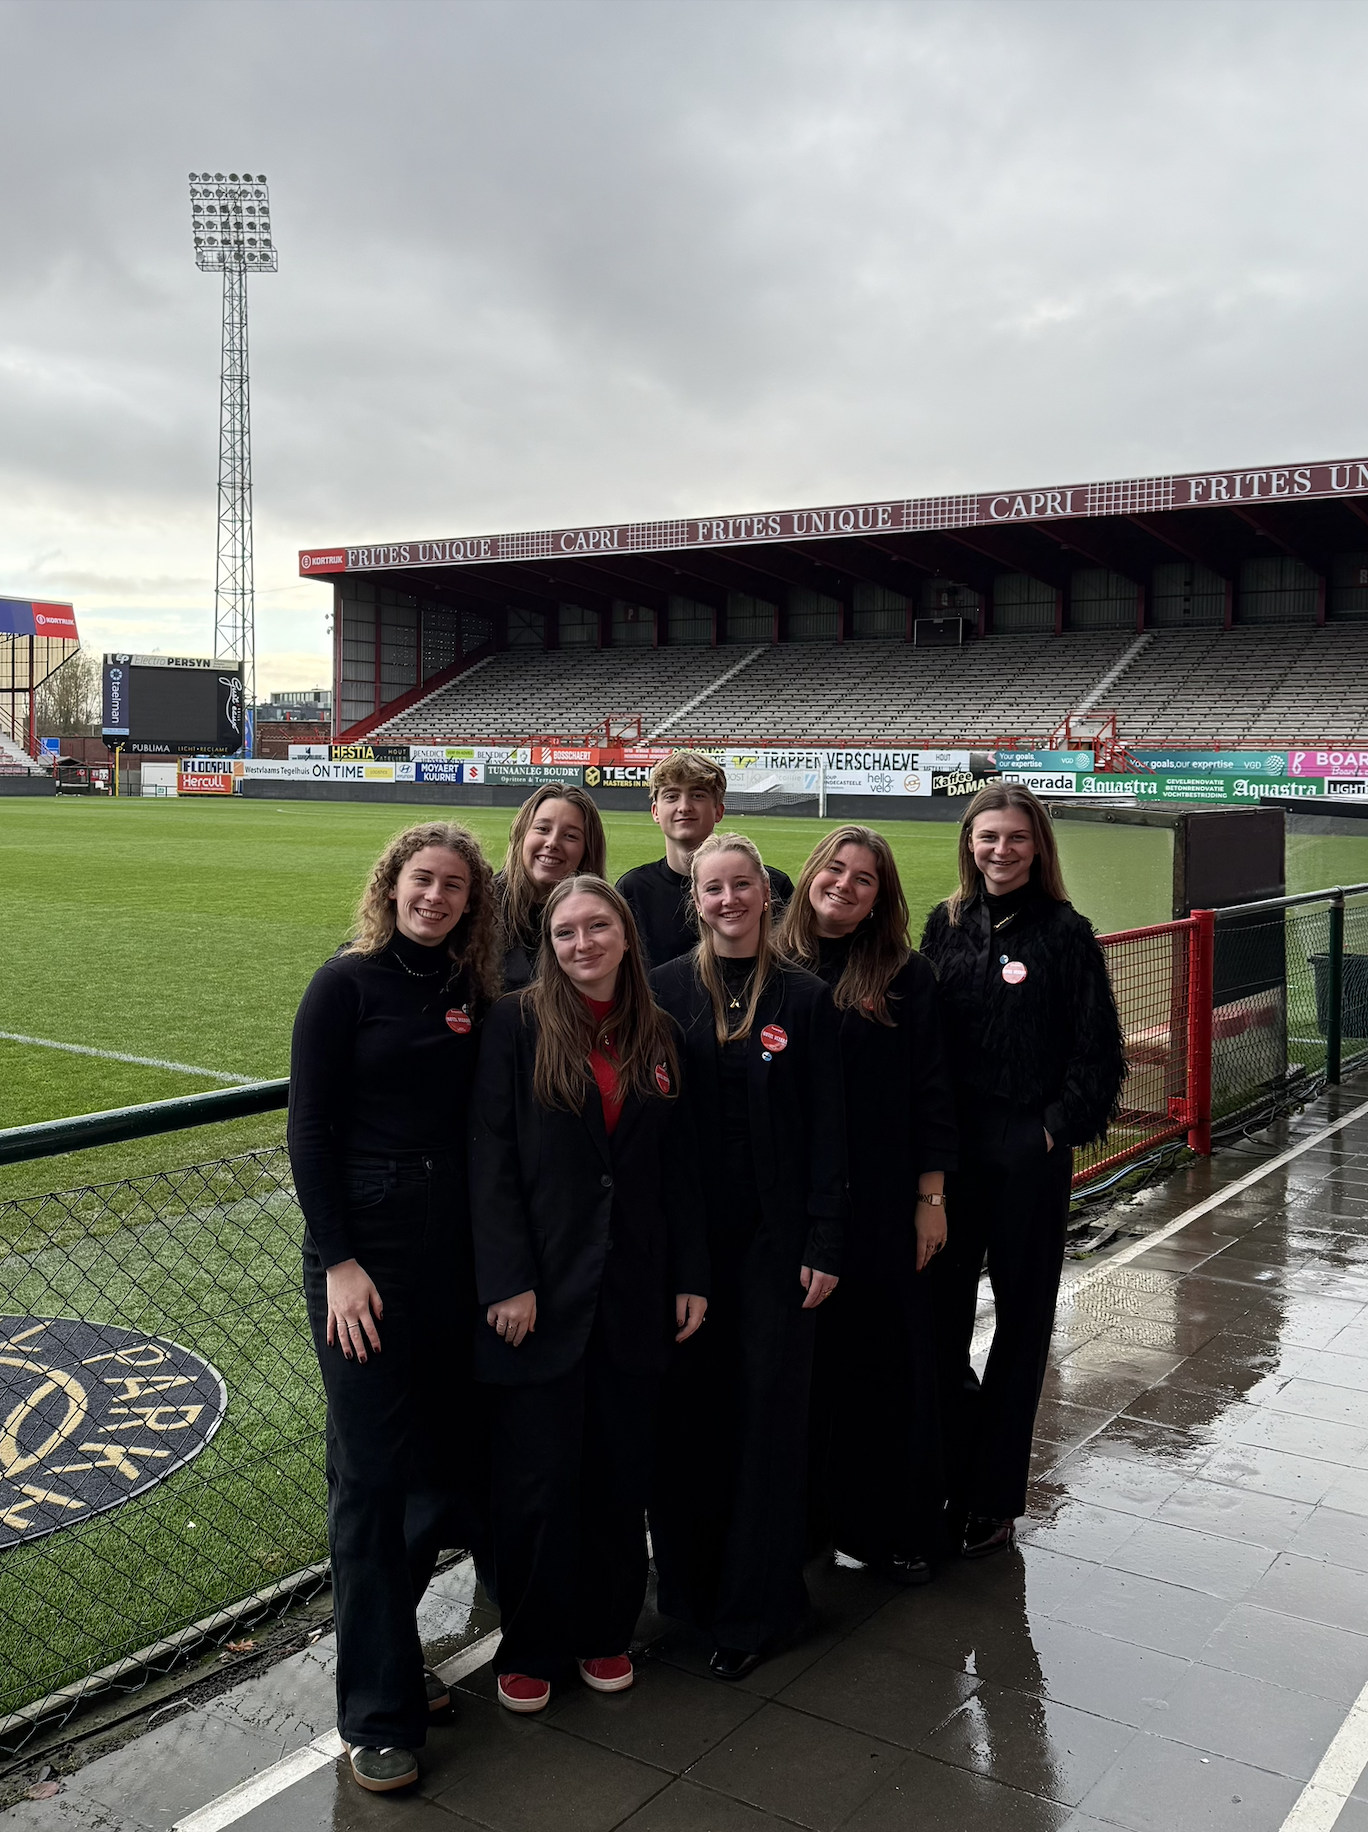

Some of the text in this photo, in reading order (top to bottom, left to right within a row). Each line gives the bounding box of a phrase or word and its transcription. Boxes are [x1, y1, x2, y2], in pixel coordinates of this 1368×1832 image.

[1188, 470, 1312, 503] FRITES
[989, 491, 1074, 519] CAPRI
[697, 507, 892, 542] FRITES UNIQUE
[560, 529, 620, 552] CAPRI
[347, 539, 491, 567] FRITES UNIQUE
[312, 556, 343, 566] KORTRIJK
[134, 655, 167, 666] Electro
[167, 658, 211, 667] PERSYN
[111, 681, 122, 724] taelman
[132, 743, 170, 753] PUBLIMA
[332, 746, 375, 759] HESTIA
[413, 749, 444, 757] BENEDICT
[477, 751, 509, 759] BENEDICT
[553, 750, 591, 760] BOSSCHAERT
[763, 751, 919, 771] TRAPPEN VERSCHAEVE
[935, 753, 951, 761] HOUT
[1000, 752, 1014, 760] Your
[1316, 752, 1368, 766] BOAR
[421, 763, 459, 773] MOYAERT
[1011, 760, 1042, 768] expertise
[1191, 759, 1234, 769] expertise
[1243, 761, 1262, 769] VGD
[245, 766, 310, 776] Westvlaams Tegelhuis
[312, 764, 364, 778] ON TIME
[488, 766, 580, 776] TUINAANLEG BOUDRY
[182, 775, 225, 788] Hercull
[423, 773, 456, 782] KUURNE
[867, 772, 891, 783] hello
[933, 771, 973, 789] Kaffee
[1022, 775, 1073, 789] verada
[1082, 776, 1158, 794] Aquastra
[1233, 779, 1317, 800] Aquastra
